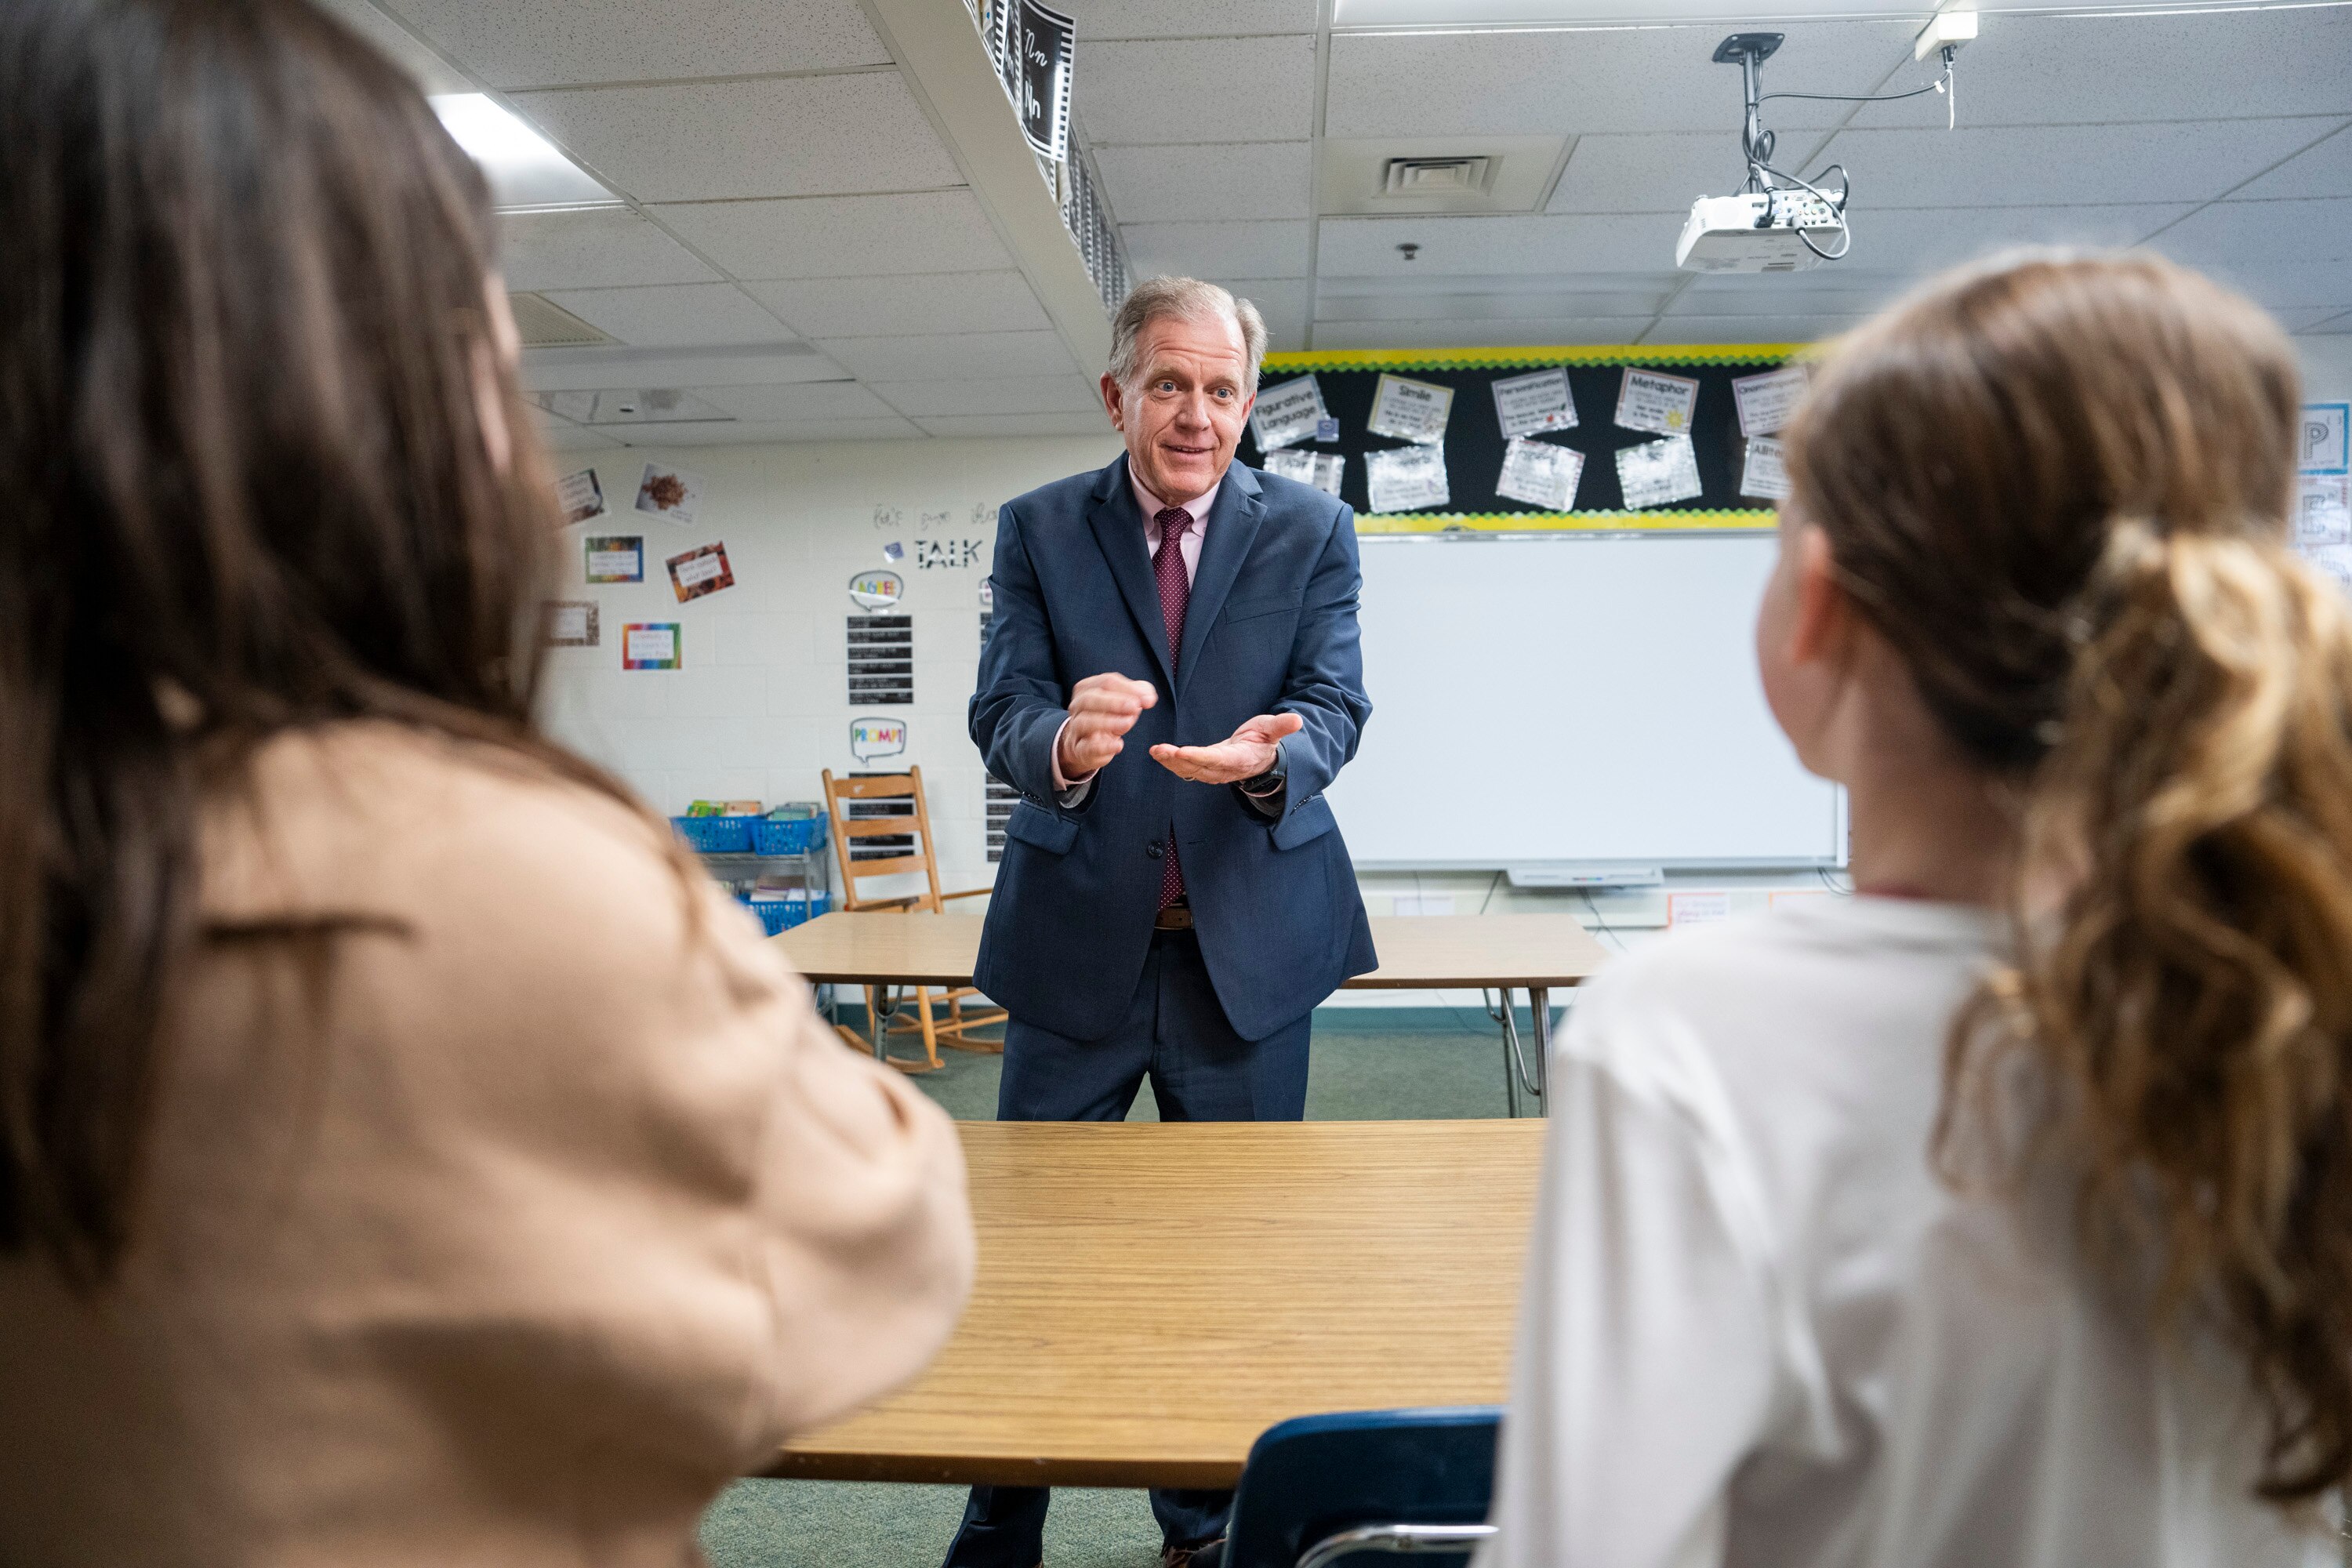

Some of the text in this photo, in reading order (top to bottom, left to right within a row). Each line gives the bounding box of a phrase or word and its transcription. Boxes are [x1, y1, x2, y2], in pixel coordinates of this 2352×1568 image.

[1025, 28, 1047, 67] Nn
[1025, 80, 1040, 119] Nn
[1399, 385, 1432, 401] Simile
[1631, 376, 1689, 394] Metaphor
[1255, 391, 1313, 416] Figurative
[1261, 406, 1316, 430] Language
[915, 539, 982, 568] TALK
[855, 727, 903, 743] PROMPT
